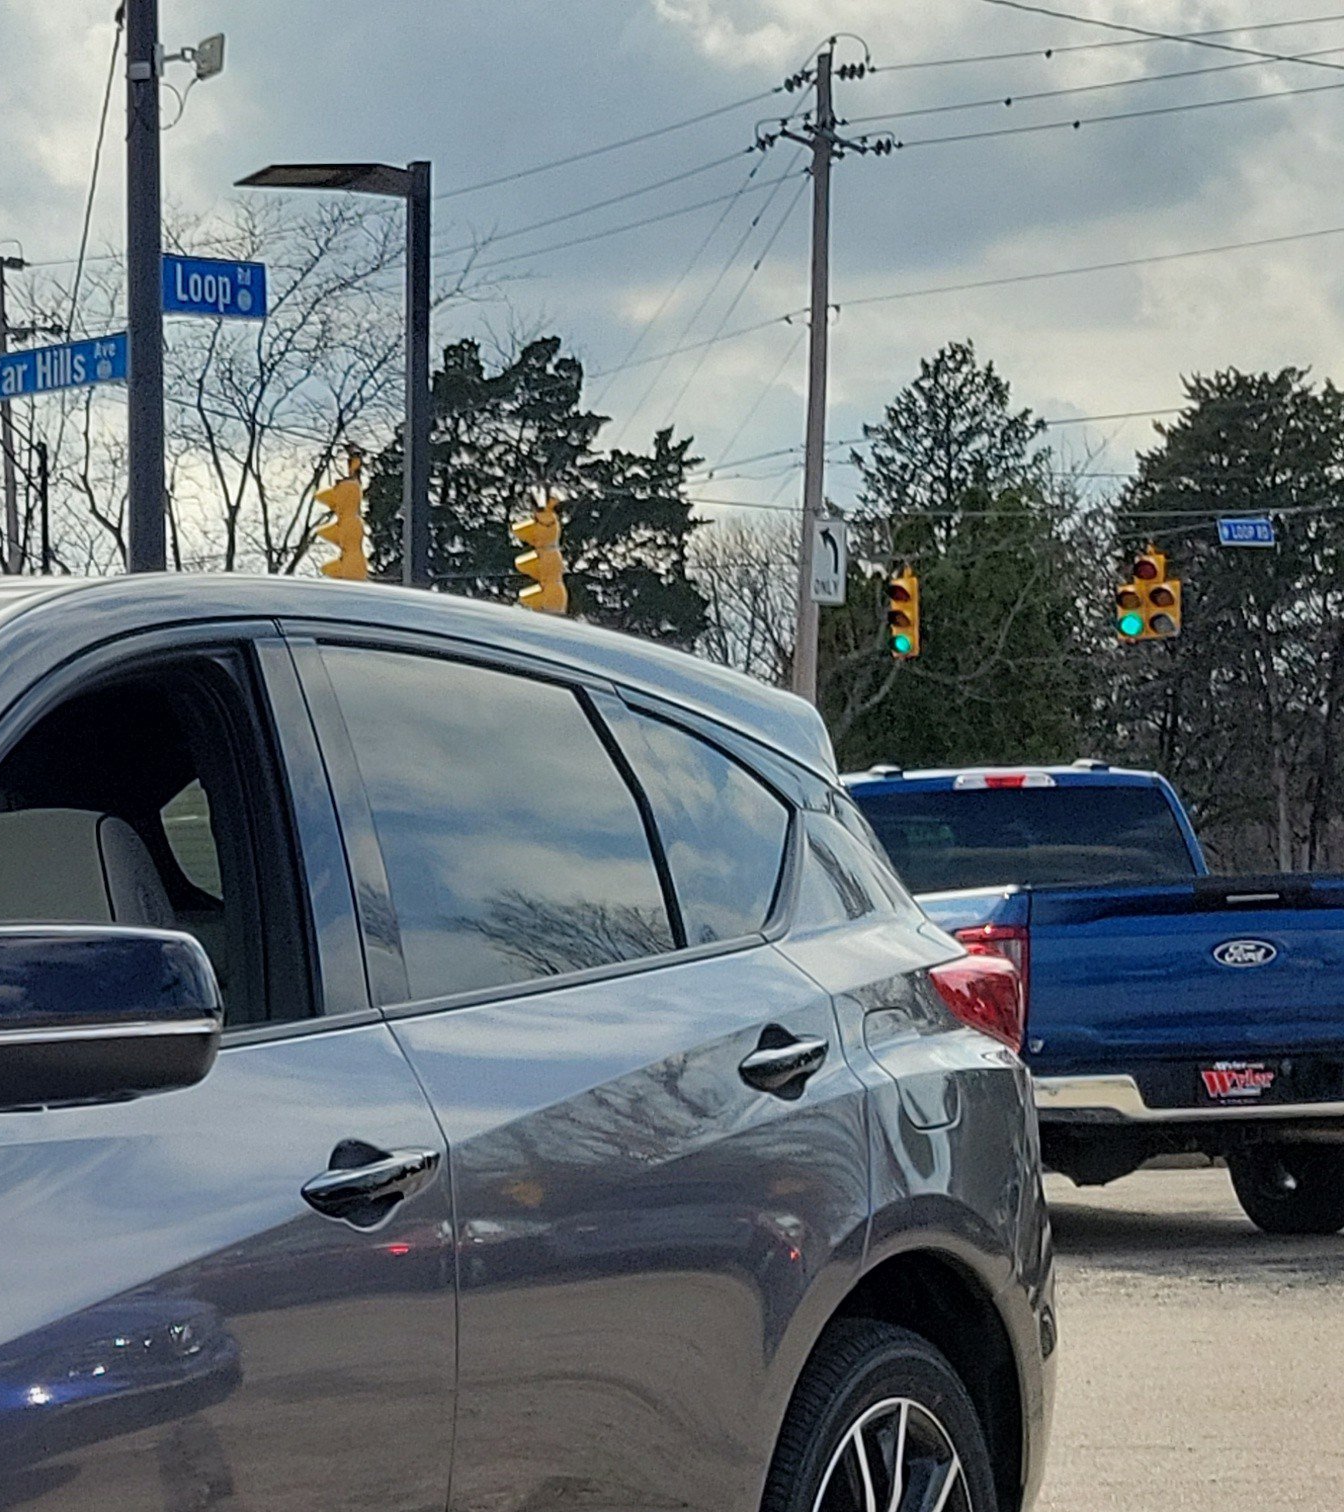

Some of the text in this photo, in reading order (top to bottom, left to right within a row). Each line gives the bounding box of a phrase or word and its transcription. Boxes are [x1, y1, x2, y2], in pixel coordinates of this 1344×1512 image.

[175, 262, 252, 313] Loop Rd
[35, 347, 86, 390] Hills
[93, 341, 116, 360] Ave
[813, 578, 840, 597] ONLY
[1201, 1068, 1274, 1098] Wyler
